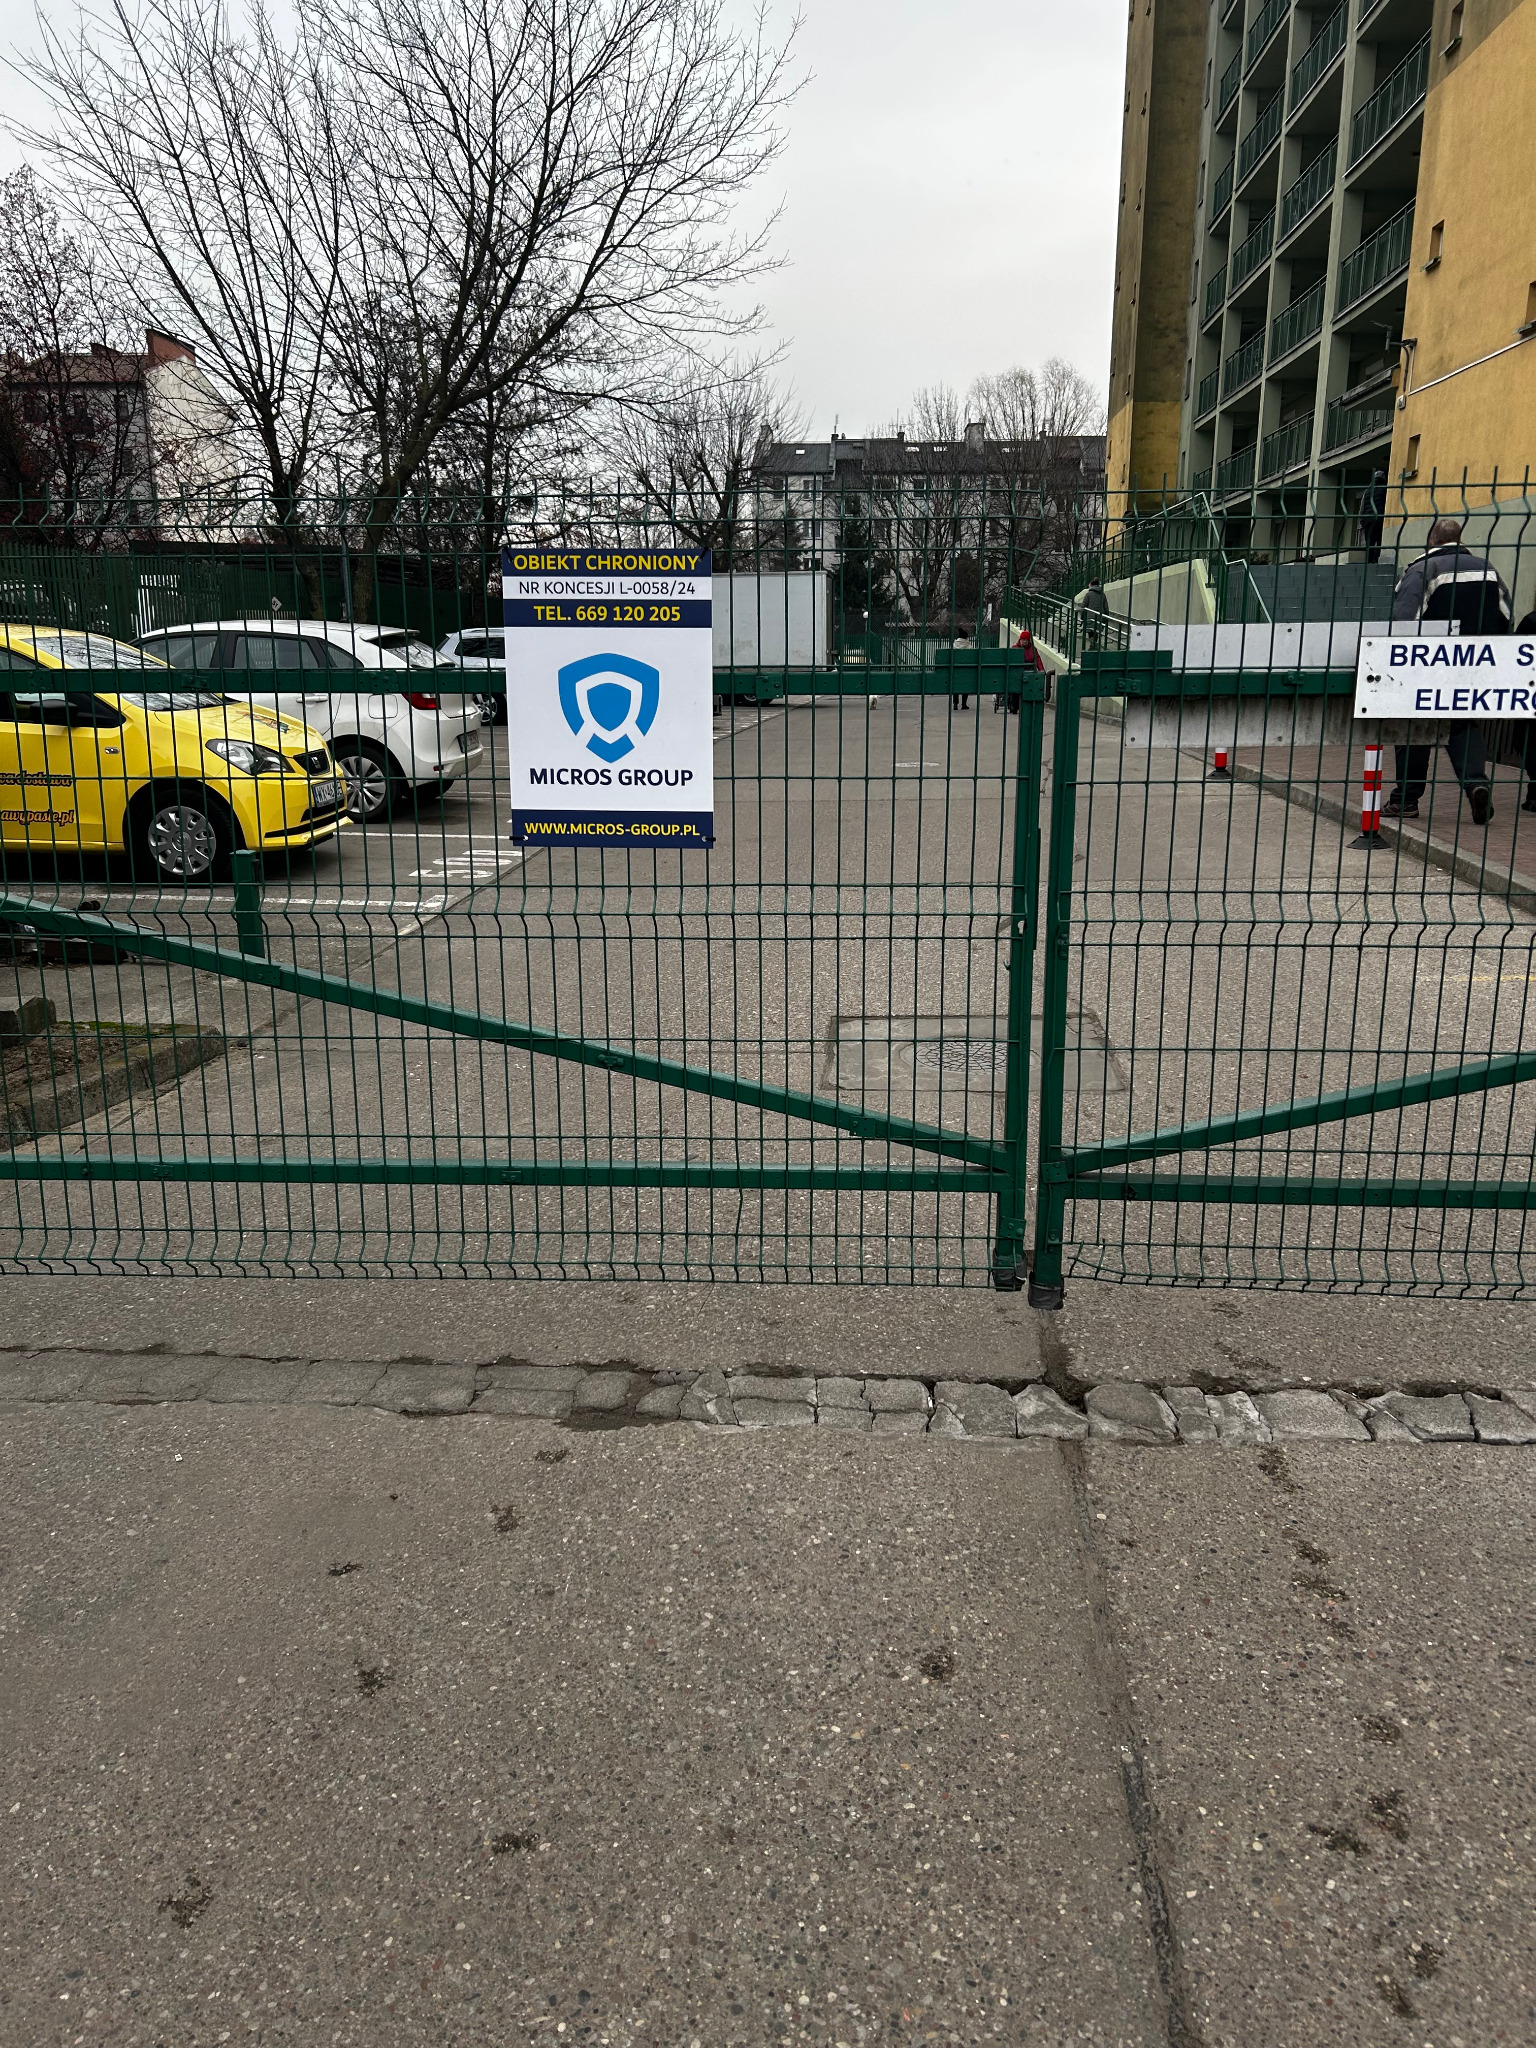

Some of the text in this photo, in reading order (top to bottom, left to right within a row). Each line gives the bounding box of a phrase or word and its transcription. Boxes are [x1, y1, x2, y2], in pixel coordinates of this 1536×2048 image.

[513, 554, 699, 571] OBIEKT CHRONIONY
[519, 579, 696, 597] NR KONCESJI L-0058/24
[533, 605, 681, 621] TEL. 669 120 205
[1389, 644, 1496, 666] BRAMA
[1415, 688, 1536, 711] ELEKTR
[529, 768, 694, 787] MICROS GROUP
[524, 822, 700, 836] WWW.MICROS-GROUP.PL
